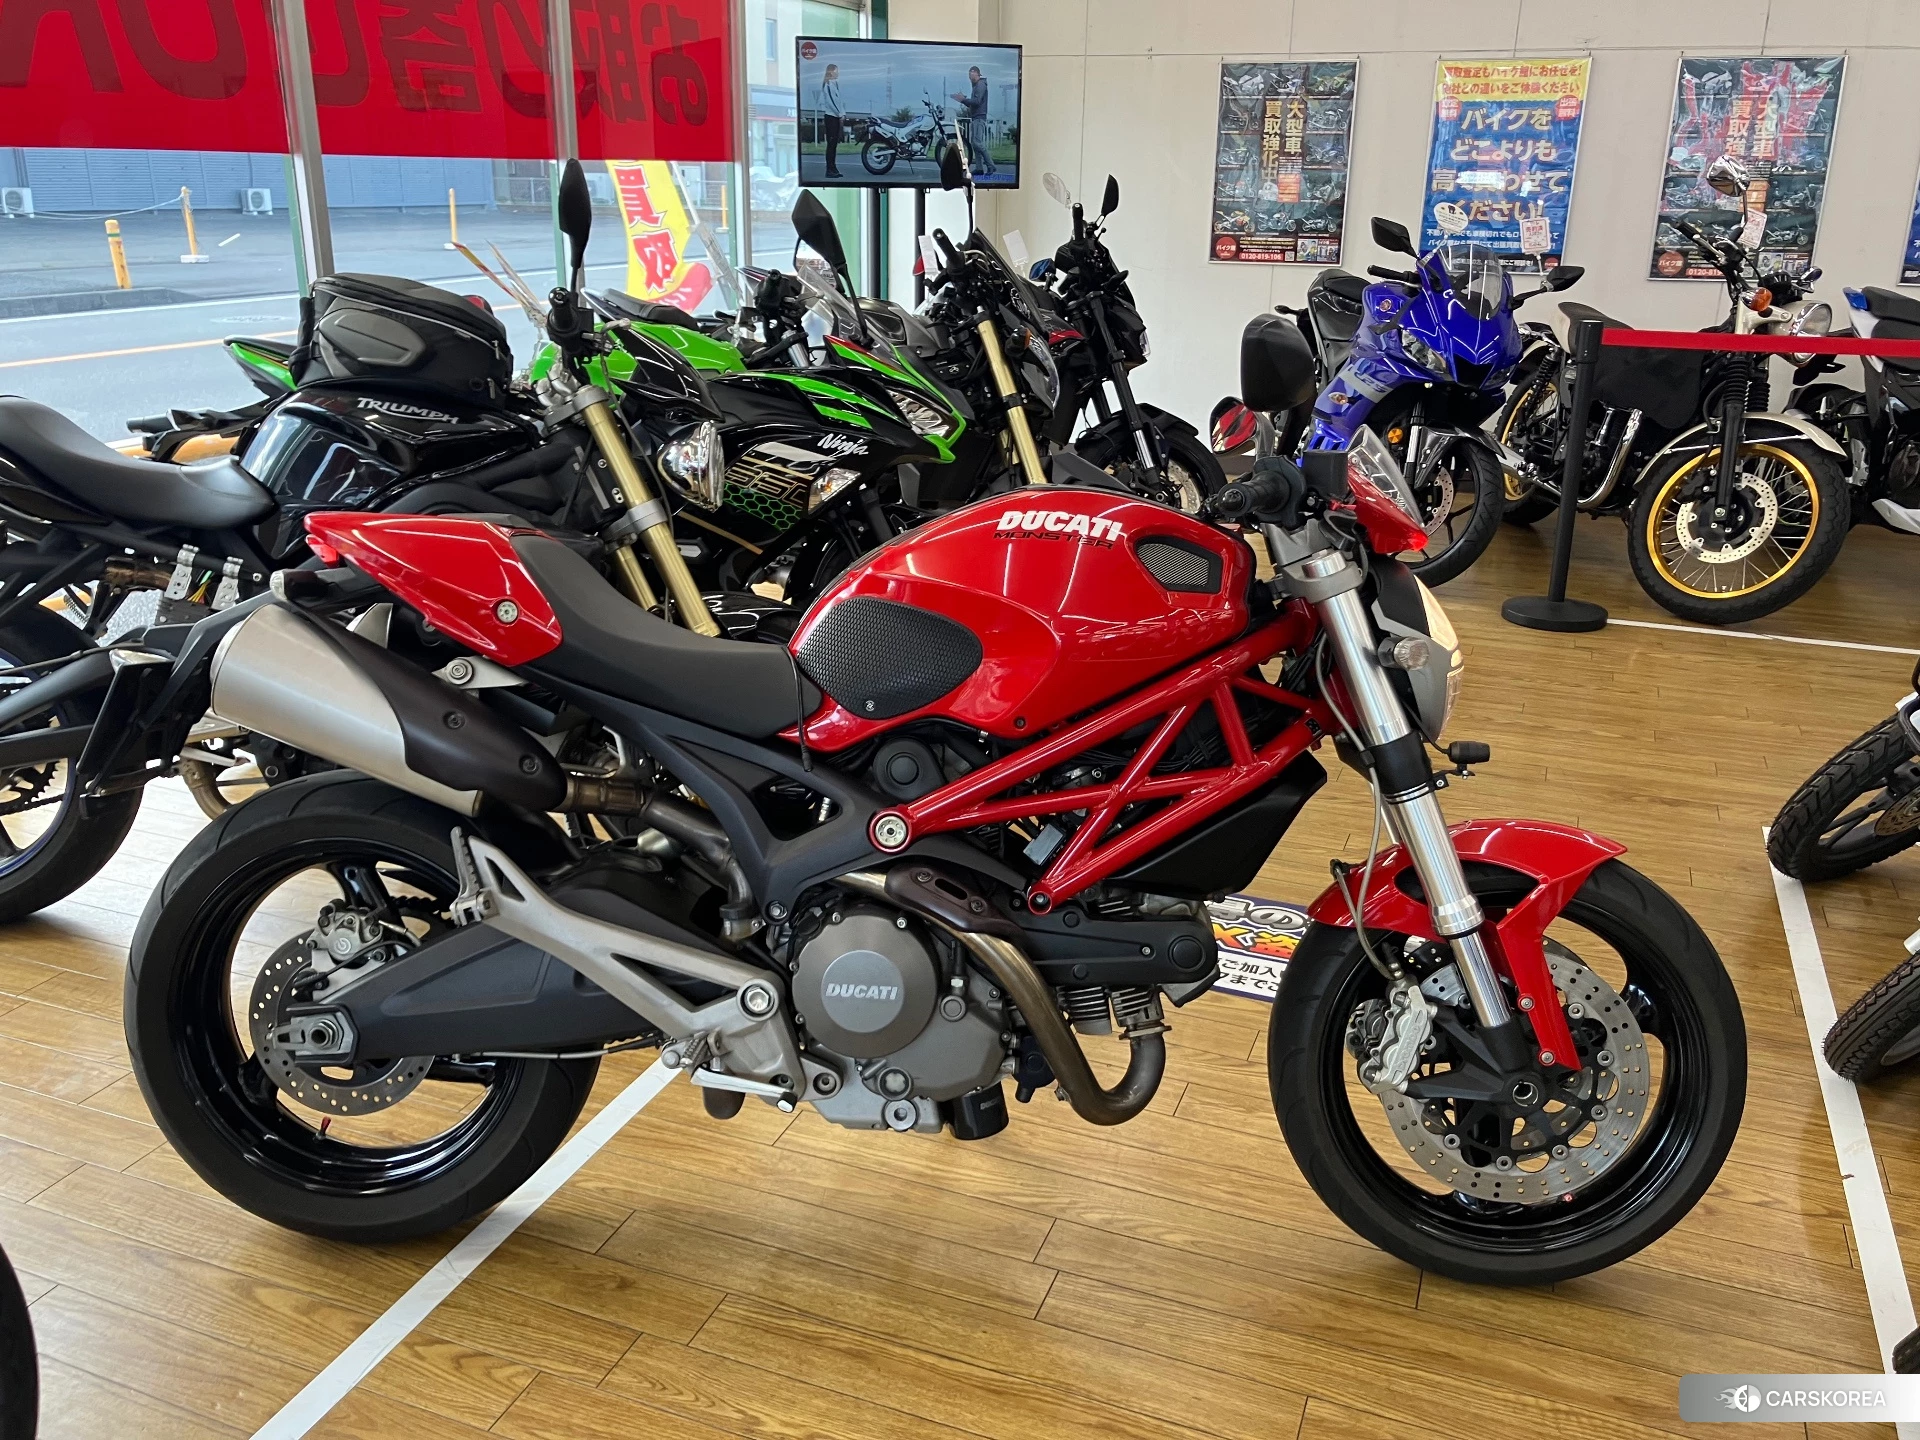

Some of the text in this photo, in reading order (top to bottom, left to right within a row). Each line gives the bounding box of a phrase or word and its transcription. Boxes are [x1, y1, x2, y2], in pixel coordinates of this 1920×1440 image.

[1285, 100, 1304, 155] 大型車
[1461, 108, 1552, 131] バイクを
[1450, 138, 1557, 161] どこよりも
[1432, 169, 1568, 192] 高わせて
[357, 397, 459, 424] TRIUMPH
[817, 433, 869, 458] Ninja
[996, 510, 1123, 541] DUCATI
[993, 531, 1114, 549] MONSTER
[1219, 957, 1285, 980] ご加入
[825, 983, 898, 1000] DUCATI
